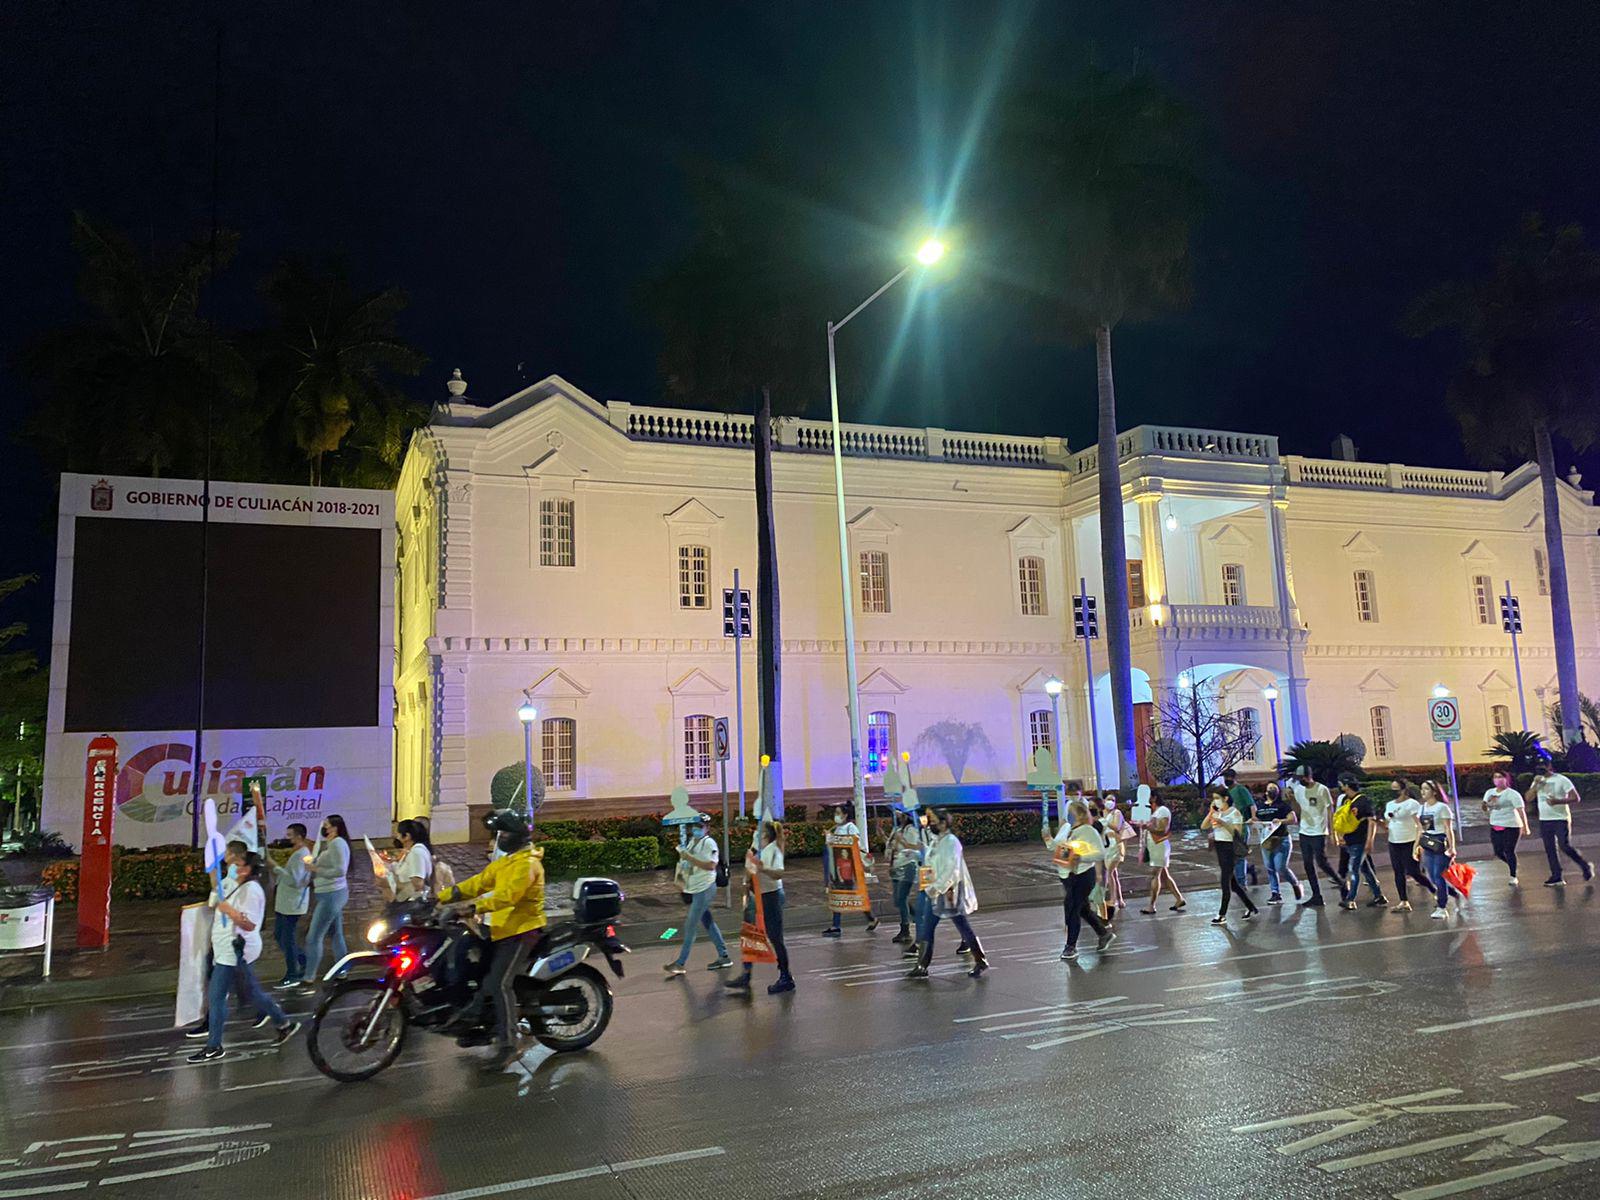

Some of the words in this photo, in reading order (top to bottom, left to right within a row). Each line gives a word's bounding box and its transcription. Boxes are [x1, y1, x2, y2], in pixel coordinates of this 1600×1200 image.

[126, 491, 210, 507] GOBIERNO
[215, 496, 234, 508] DE
[237, 497, 313, 512] CULIACÁN
[316, 501, 380, 515] 2018-2021
[1437, 705, 1450, 718] 30
